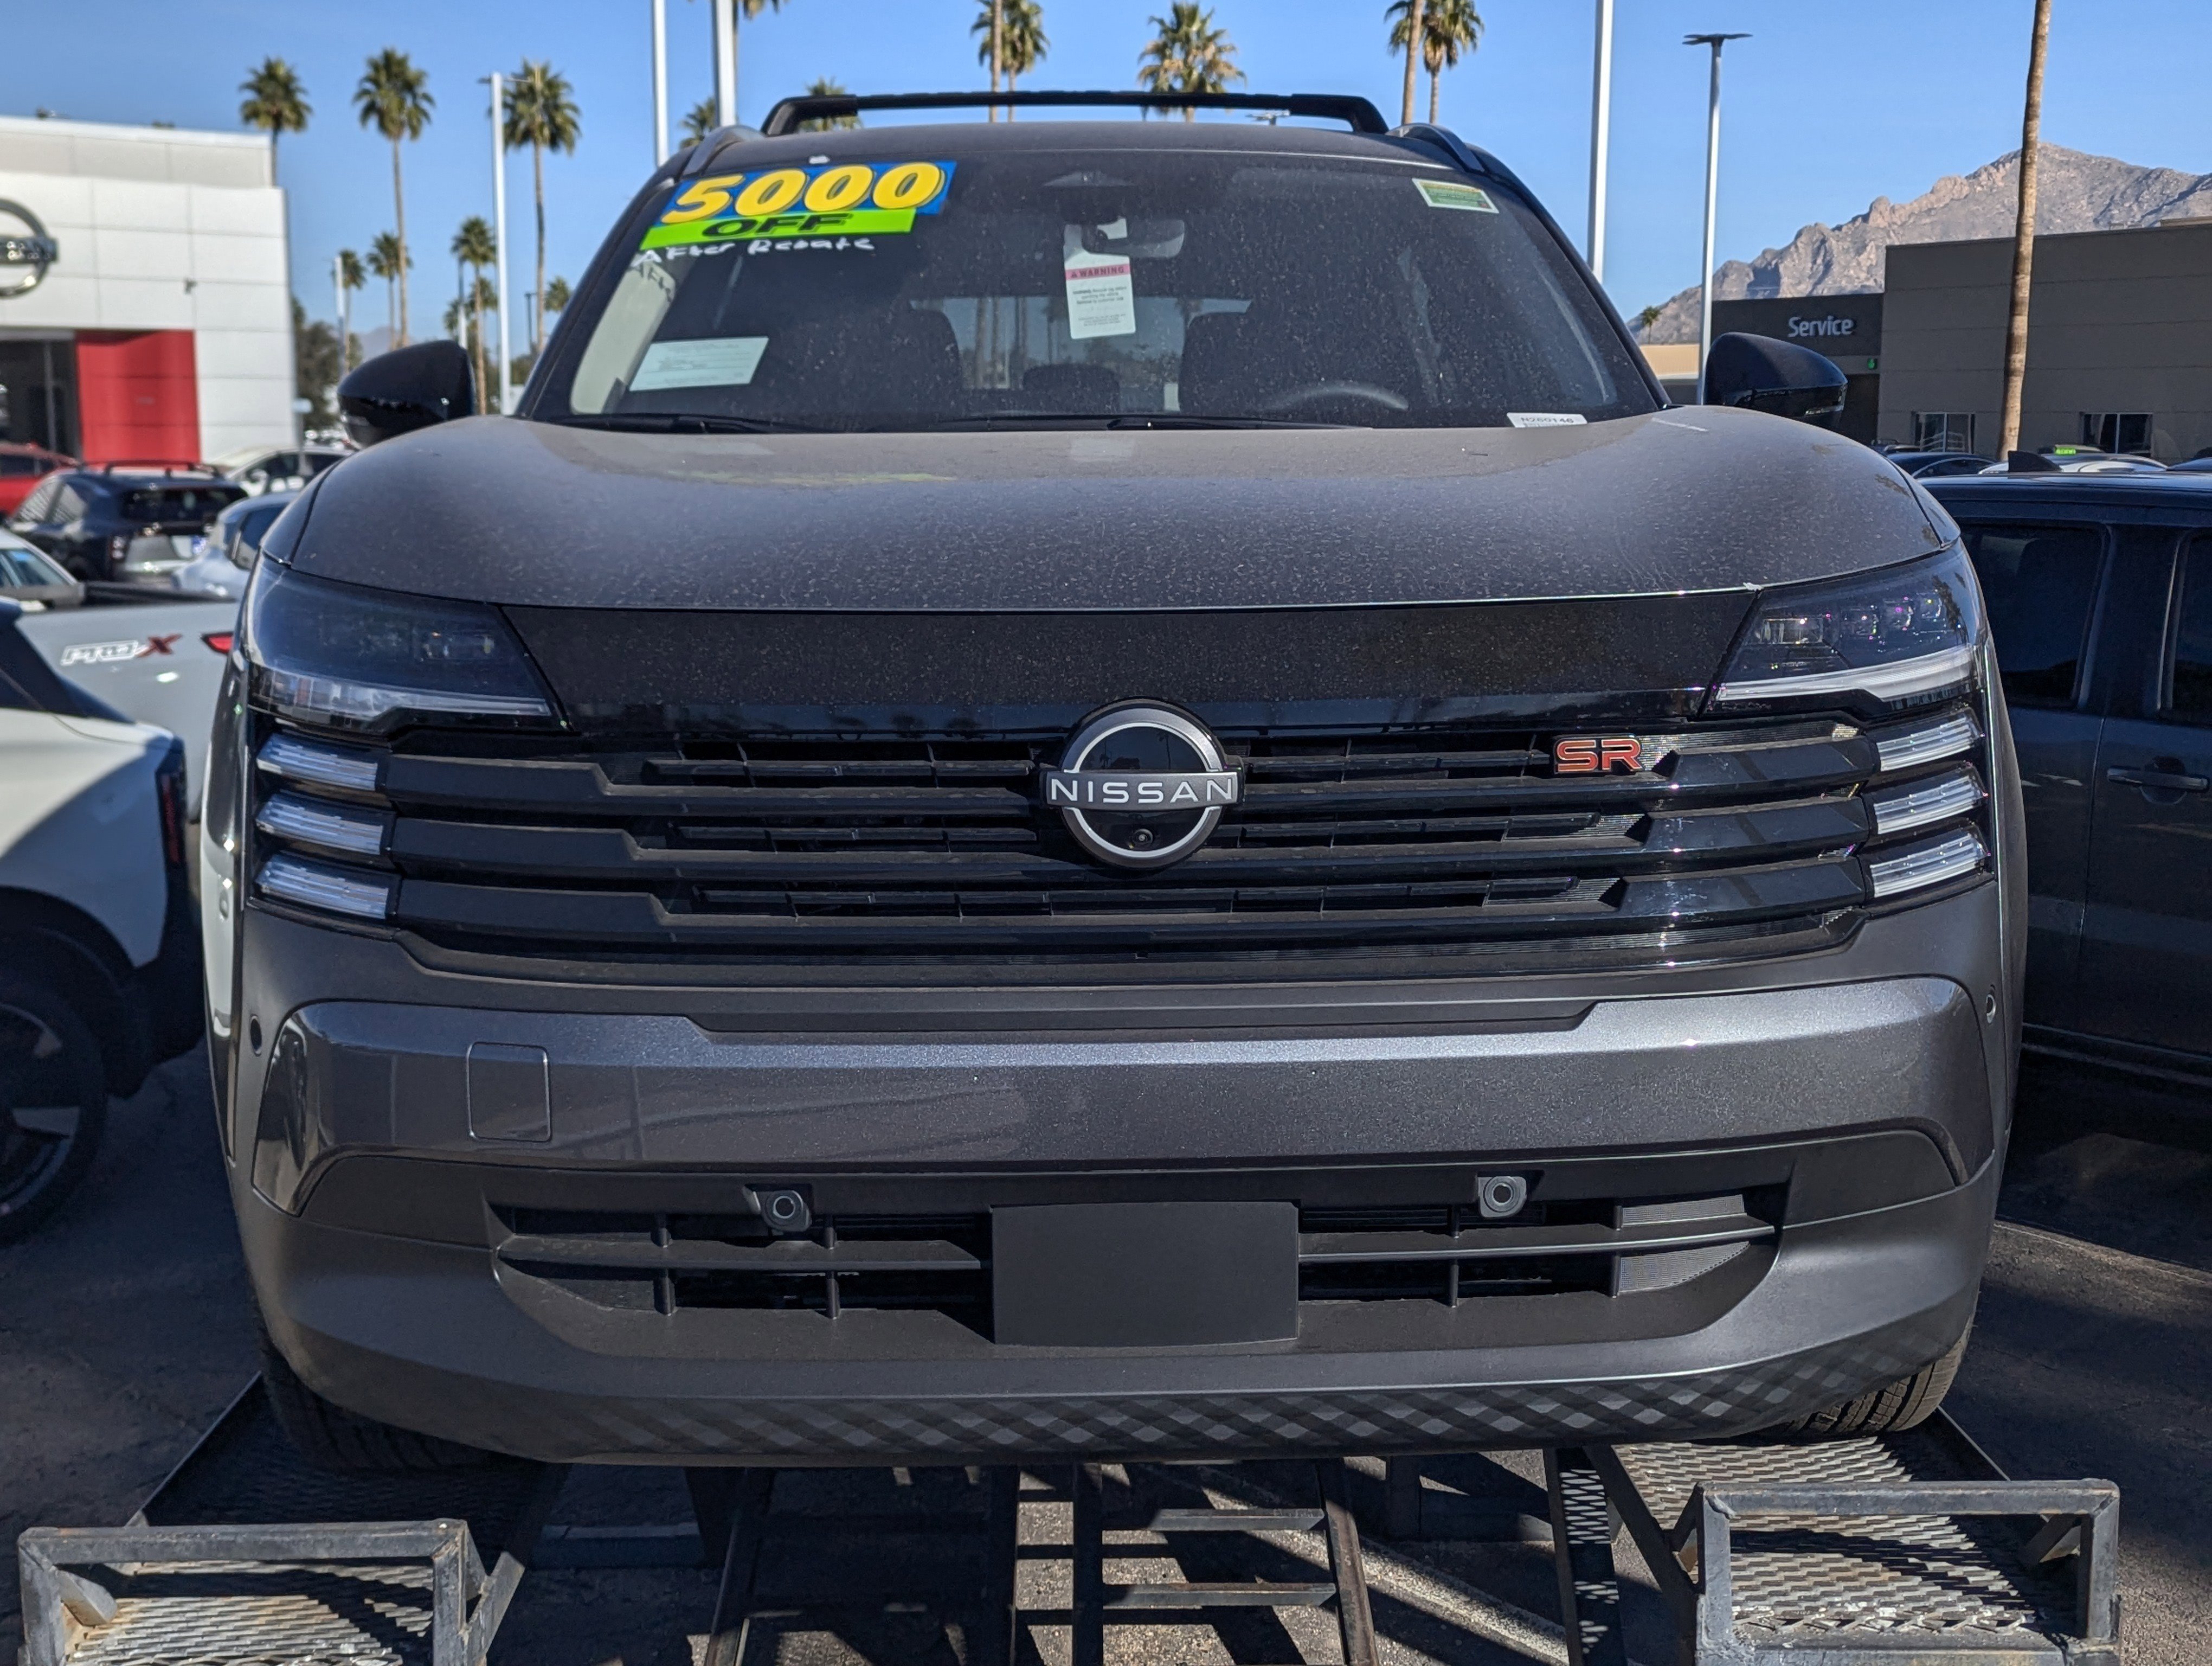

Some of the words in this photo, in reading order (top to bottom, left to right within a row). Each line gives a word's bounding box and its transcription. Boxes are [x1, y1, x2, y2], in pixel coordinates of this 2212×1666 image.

[661, 162, 945, 223] 5000
[702, 213, 853, 237] OFF
[1079, 266, 1125, 278] WARNING
[1787, 315, 1855, 338] Service
[1557, 738, 1643, 773] SR
[1051, 778, 1232, 804] NISSAN
